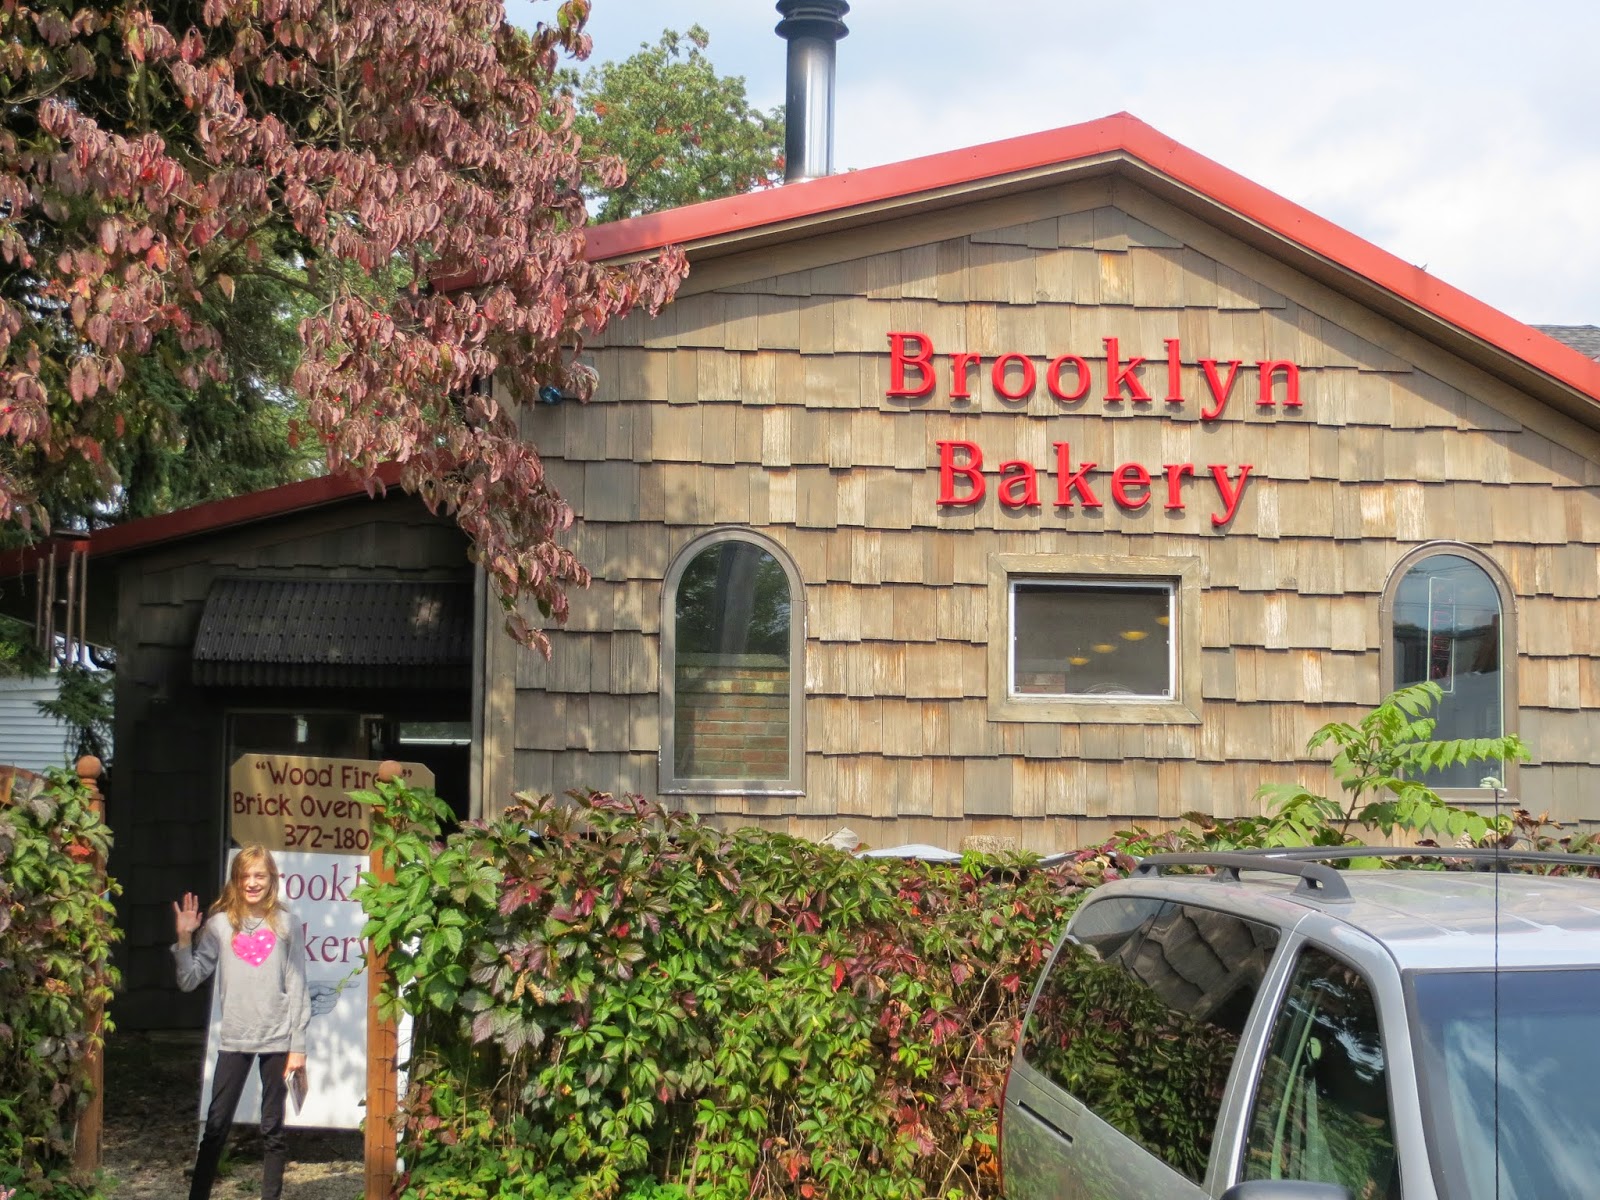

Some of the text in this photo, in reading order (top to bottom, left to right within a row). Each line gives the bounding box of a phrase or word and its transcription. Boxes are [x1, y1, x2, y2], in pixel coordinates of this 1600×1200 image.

[886, 331, 1303, 420] Brooklyn
[936, 440, 1253, 527] Bakery
[341, 765, 413, 790] Fir”
[234, 791, 362, 819] Brick Oven
[284, 824, 369, 850] 372-180
